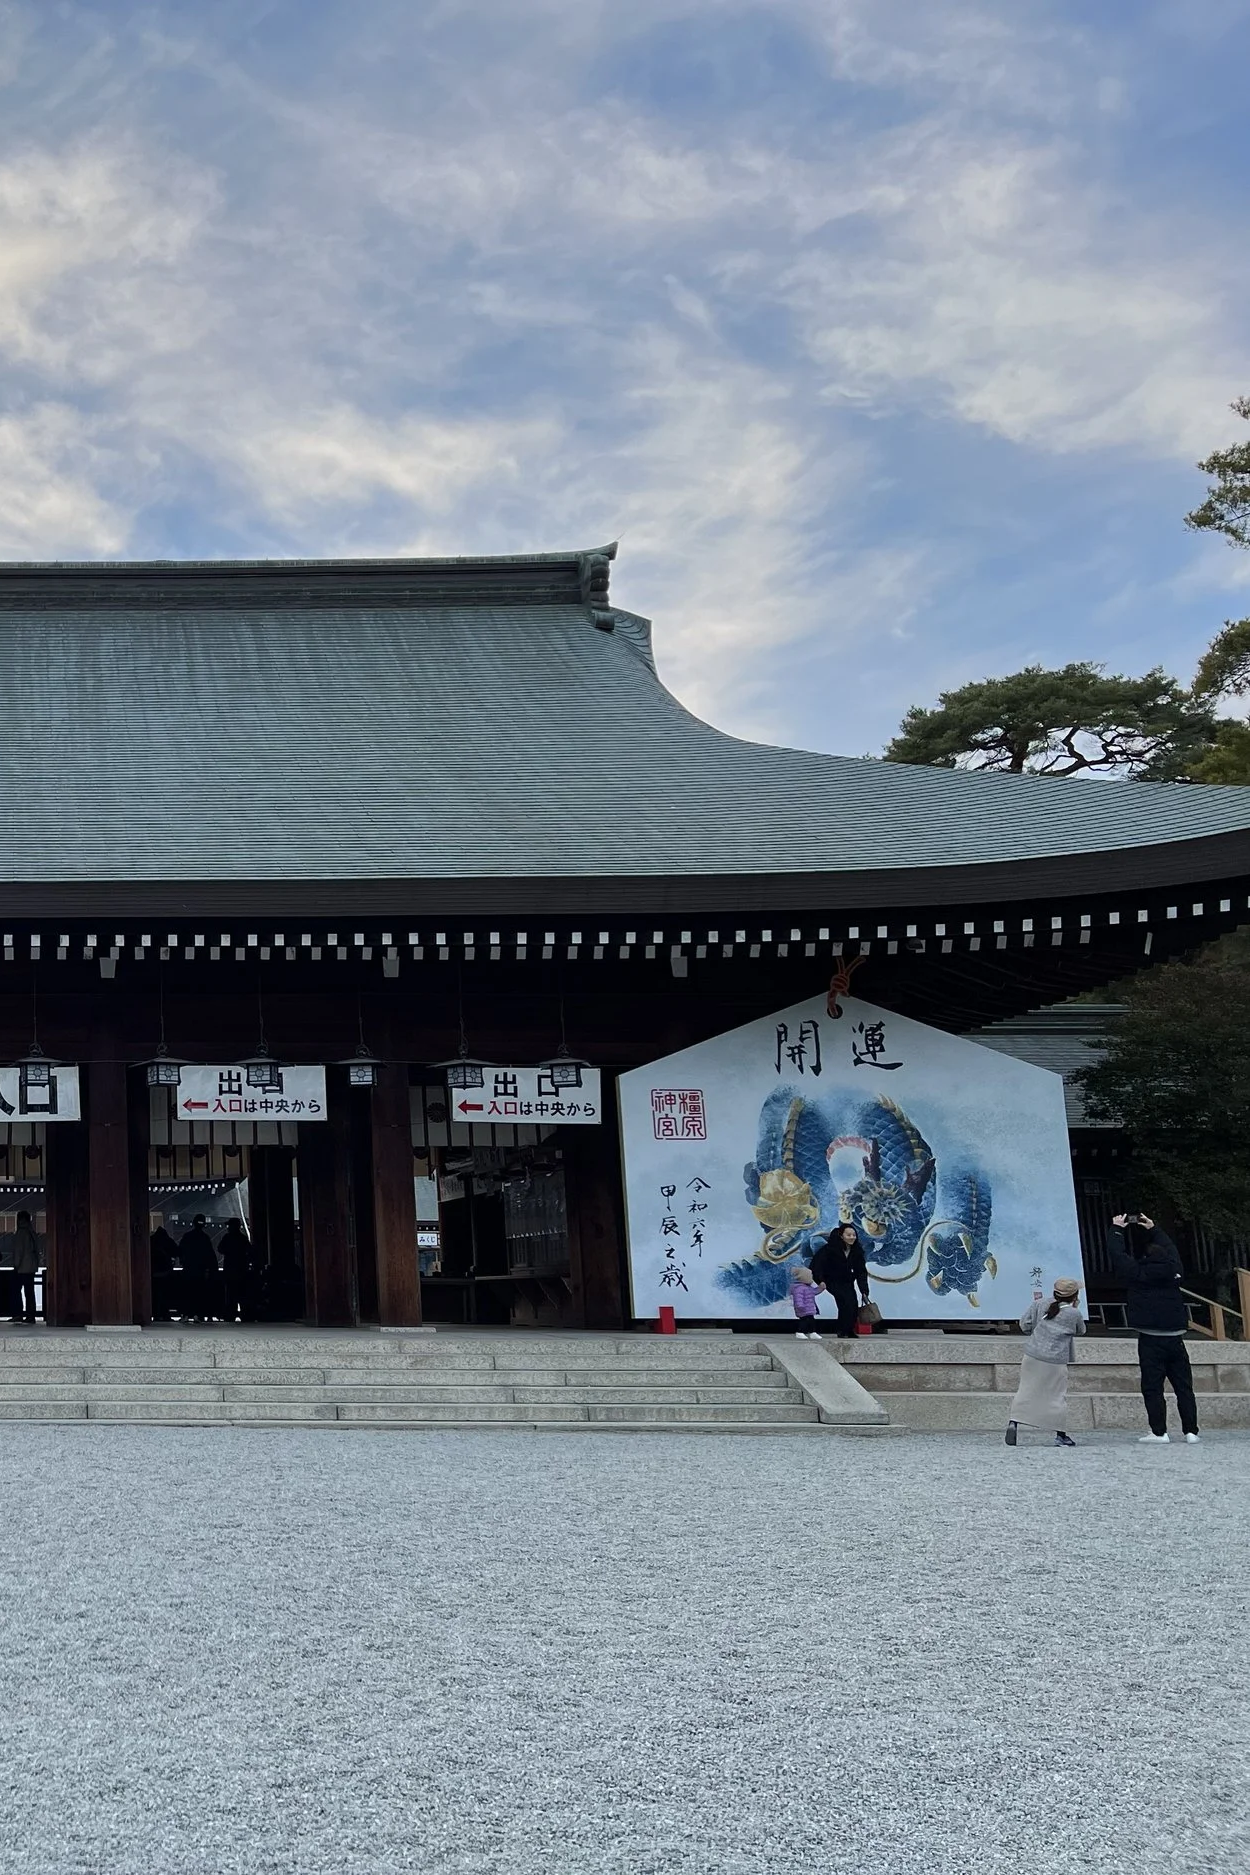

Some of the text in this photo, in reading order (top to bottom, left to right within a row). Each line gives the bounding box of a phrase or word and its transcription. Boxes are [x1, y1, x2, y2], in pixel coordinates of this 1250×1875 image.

[775, 1020, 903, 1076] 開運
[494, 1072, 559, 1098] 出口
[212, 1099, 321, 1113] 入口は中央から
[488, 1101, 596, 1116] 入口は中央から
[686, 1177, 711, 1257] 令和六年
